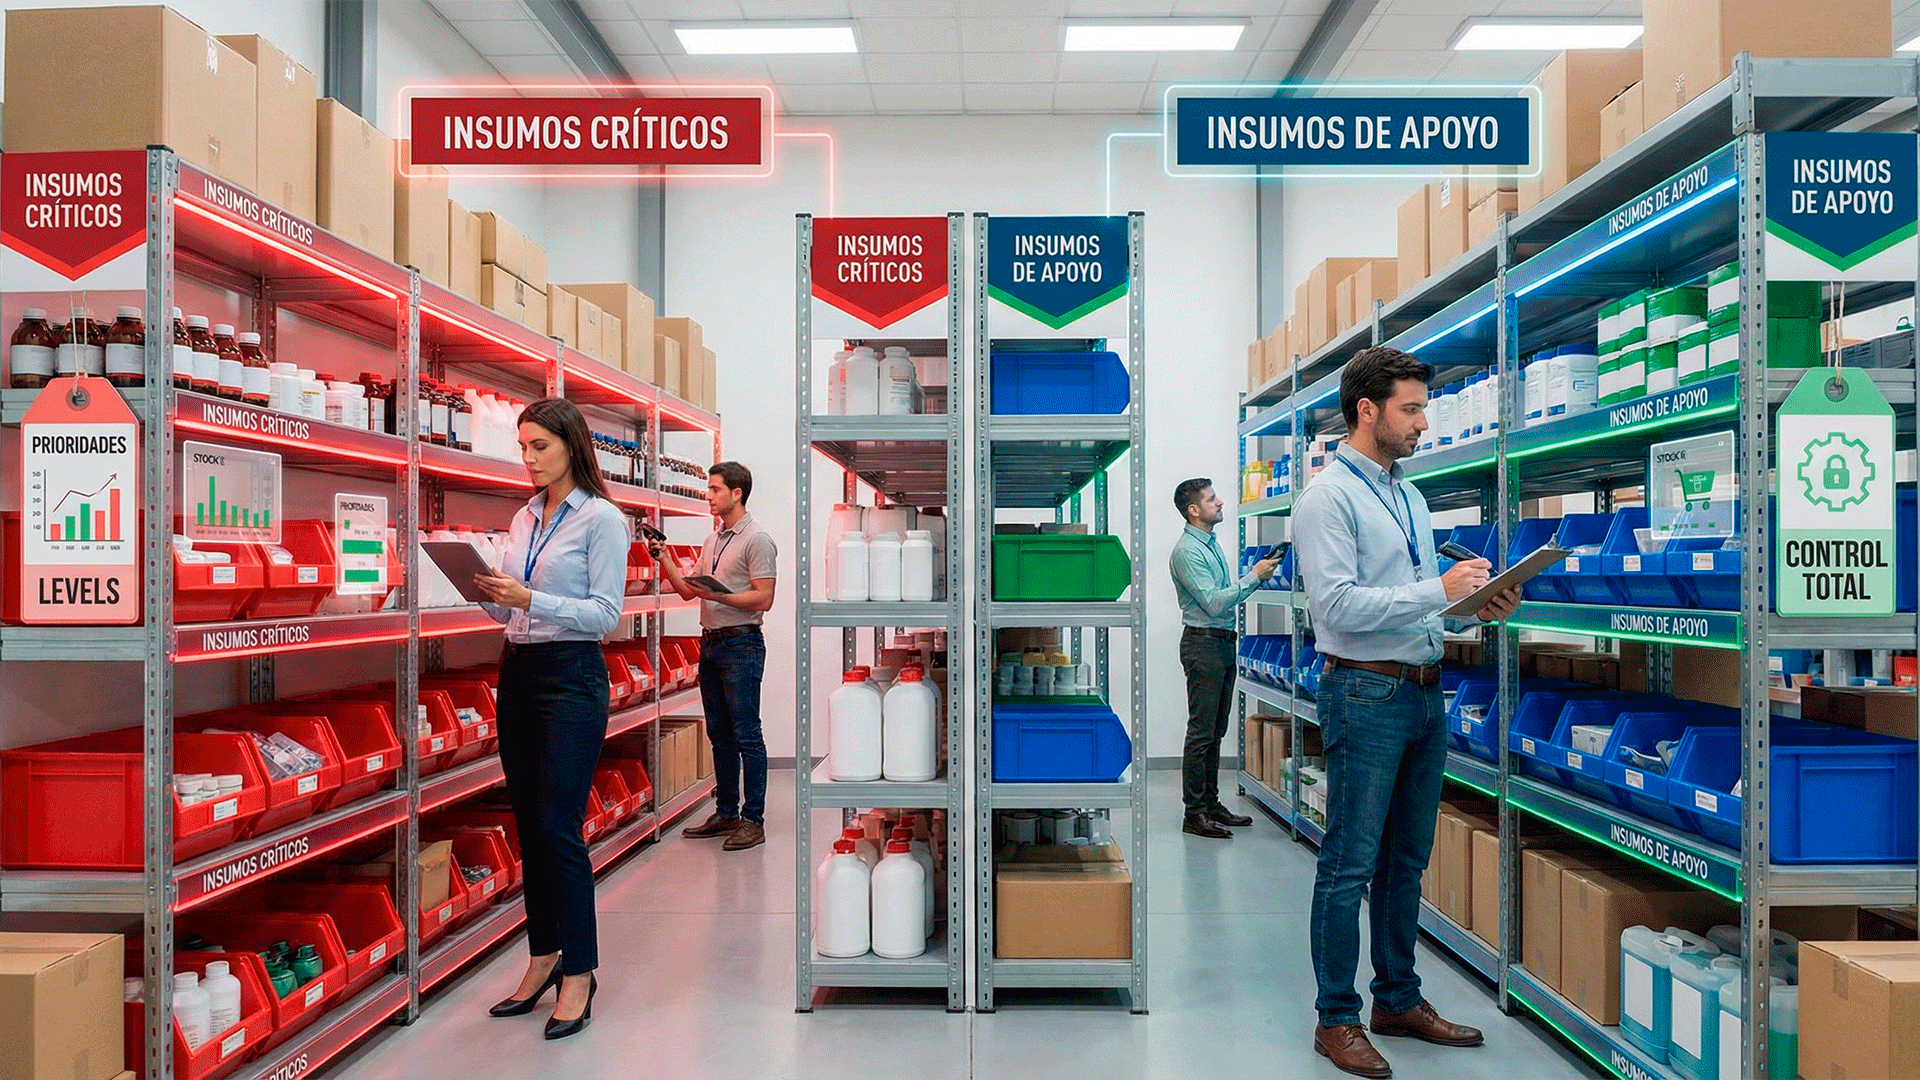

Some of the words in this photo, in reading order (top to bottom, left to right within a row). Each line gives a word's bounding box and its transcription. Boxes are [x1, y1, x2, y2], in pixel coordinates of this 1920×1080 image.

[25, 173, 122, 197] INSUMOS
[1793, 159, 1892, 184] INSUMOS
[25, 198, 122, 228] CRÍTICOS
[204, 178, 259, 222] INSUMOS
[261, 210, 313, 246] CRÍTICOS
[1608, 196, 1654, 236] INSUMOS
[1655, 186, 1670, 212] DE
[1671, 165, 1708, 203] APOYO
[1791, 190, 1819, 214] DE
[1824, 190, 1894, 214] APOYO
[837, 235, 923, 256] INSUMOS
[1014, 235, 1100, 256] INSUMOS
[837, 257, 923, 283] CRÍTICOS
[1013, 261, 1035, 283] DE
[1041, 261, 1103, 283] APOYO
[203, 403, 258, 431] INSUMOS
[260, 413, 310, 440] CRÍTICOS
[1609, 401, 1654, 428] INSUMOS
[1656, 396, 1670, 417] DE
[1671, 387, 1708, 414] APOYO
[32, 436, 127, 454] PRIORIDADES
[1785, 540, 1889, 568] CONTROL
[39, 578, 120, 605] LEVELS
[1802, 573, 1871, 601] TOTAL
[203, 628, 258, 652] INSUMOS
[260, 622, 310, 646] CRÍTICOS
[1611, 613, 1655, 634] INSUMOS
[1656, 616, 1670, 635] DE
[1672, 617, 1708, 638] APOYO
[203, 856, 258, 893] INSUMOS
[260, 836, 309, 870] CRÍTICOS
[1610, 823, 1654, 857] INSUMOS
[1656, 841, 1670, 864] DE
[1671, 850, 1708, 880] APOYO
[1611, 1049, 1655, 1080] INSUMO
